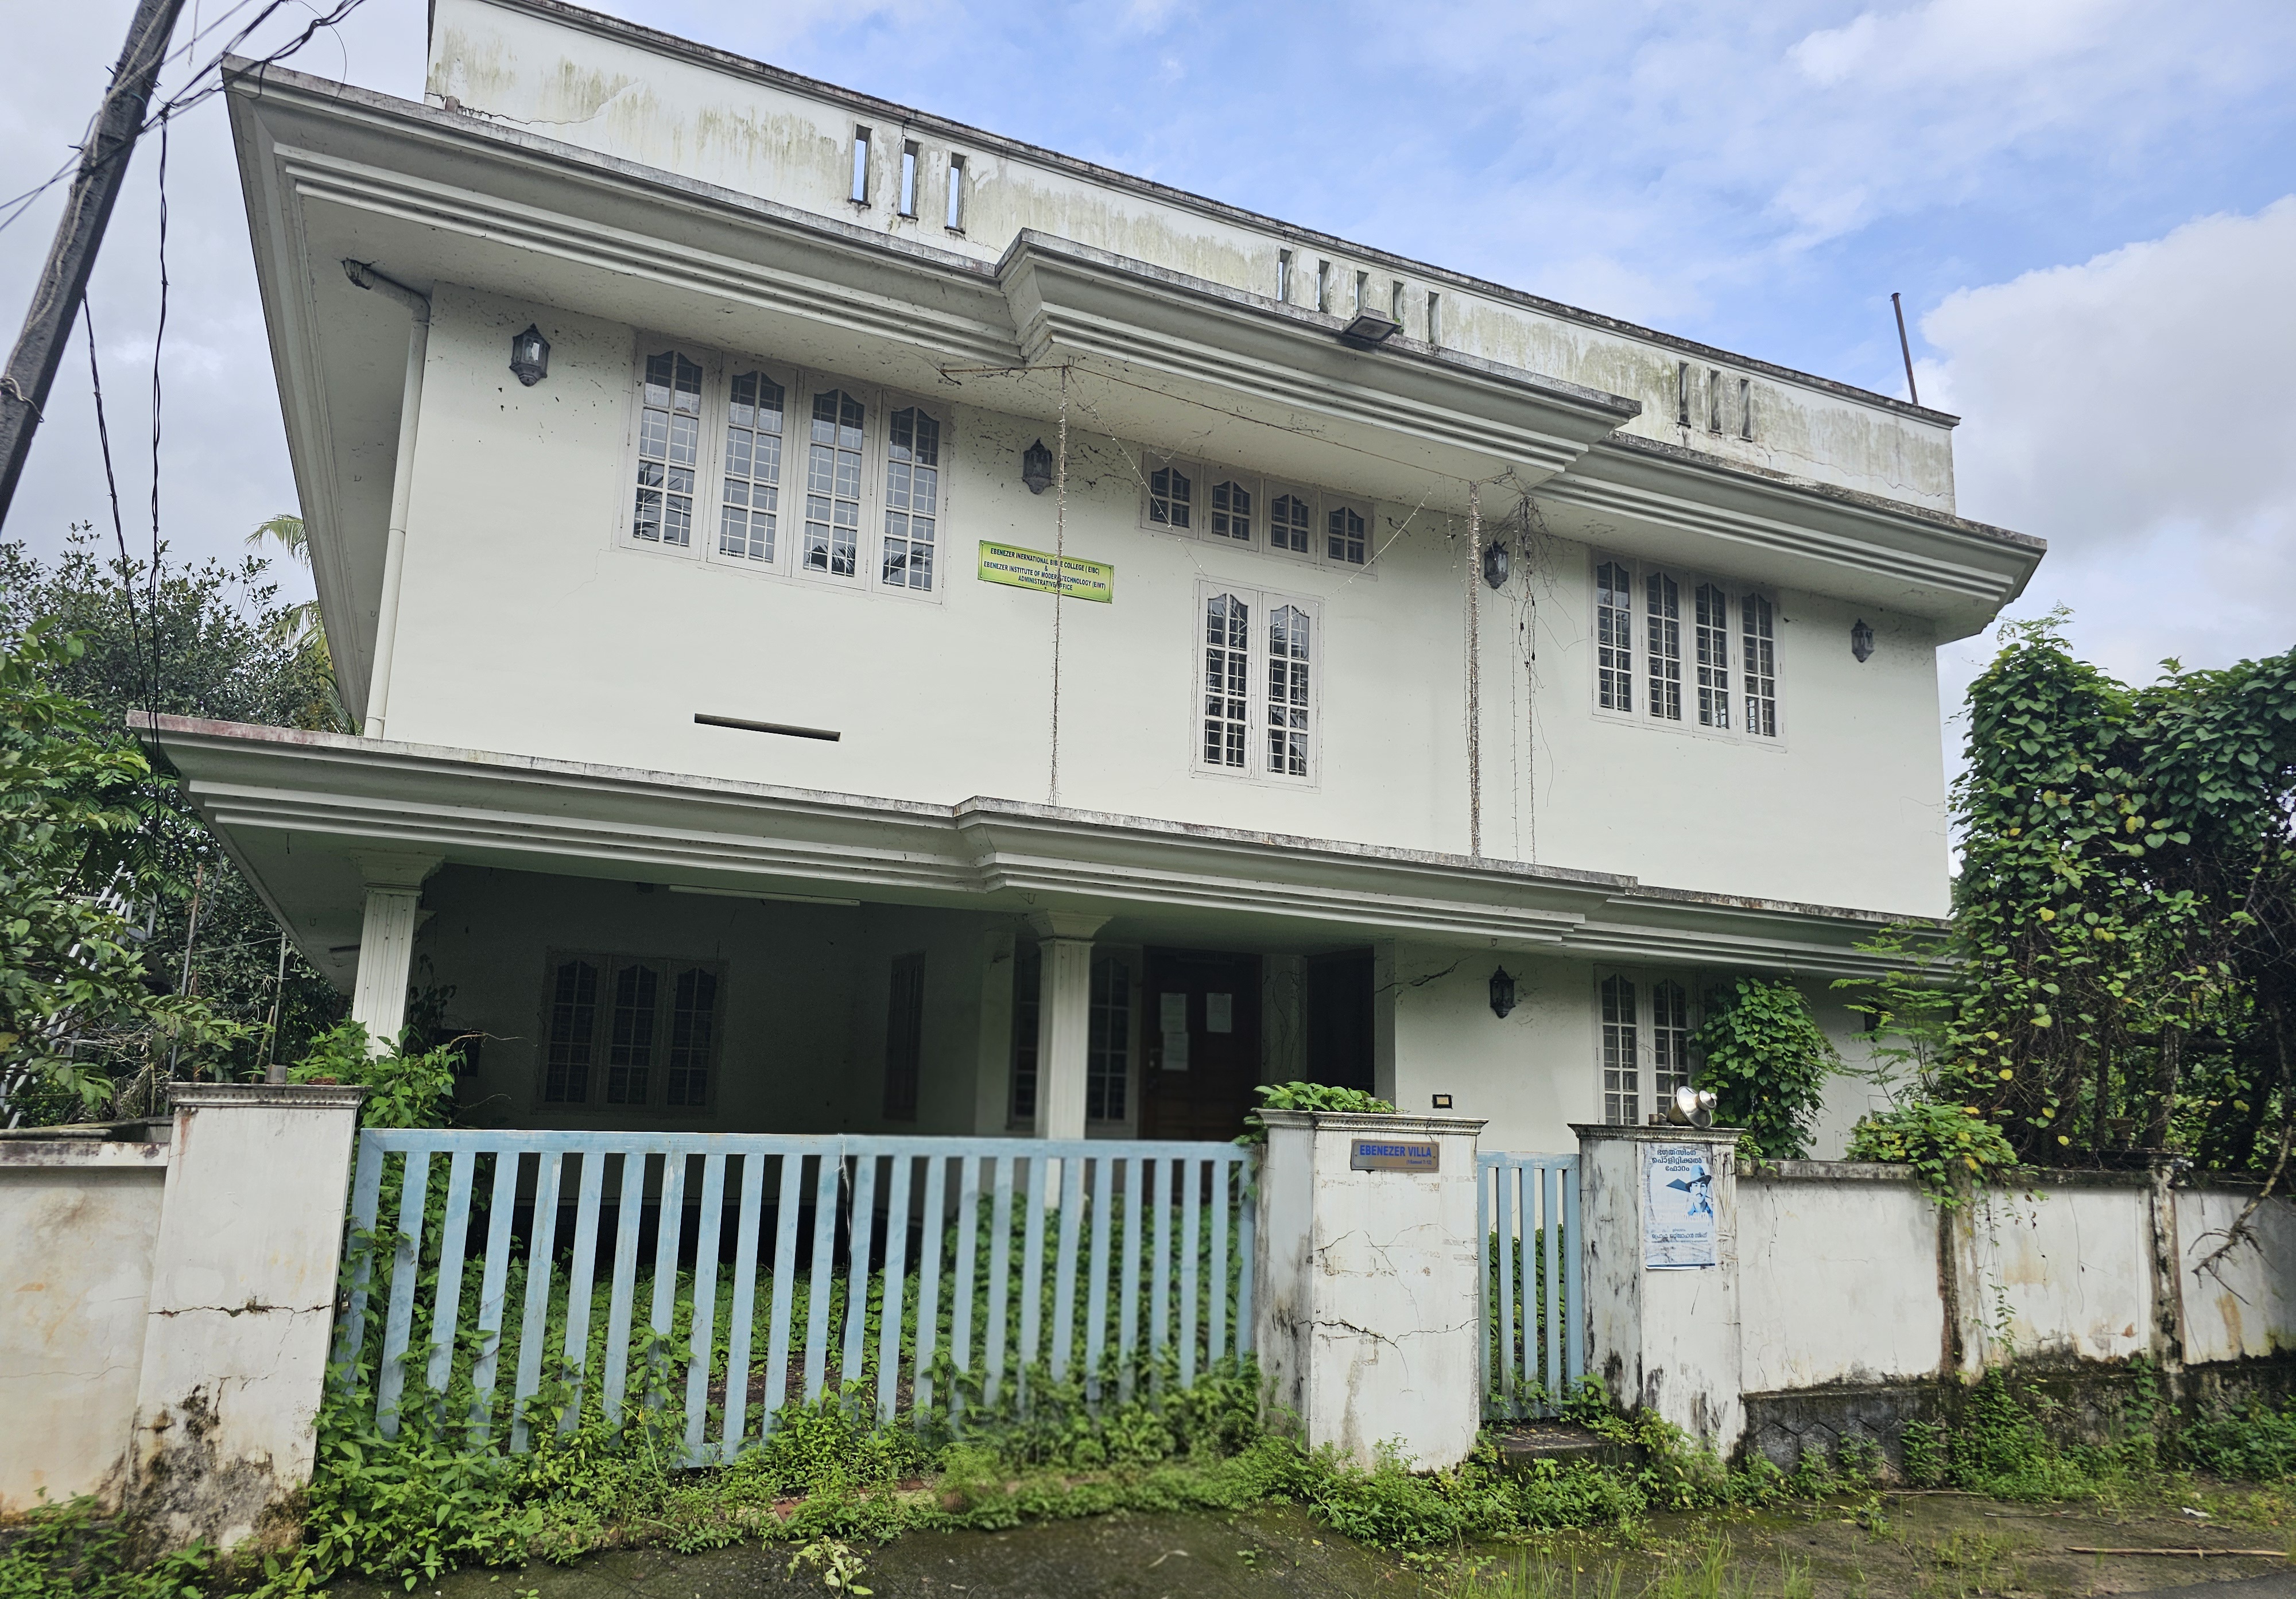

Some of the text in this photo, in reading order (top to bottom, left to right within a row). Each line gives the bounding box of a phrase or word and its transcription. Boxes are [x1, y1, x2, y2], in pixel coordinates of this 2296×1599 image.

[991, 548, 1015, 558] EBENEZER
[1016, 553, 1049, 564] INERNATIONAL
[1064, 562, 1084, 571] COLLEGE
[984, 561, 1008, 570] EBENEZER
[1009, 566, 1033, 575] INSTITUTE
[1041, 572, 1060, 581] MODER
[1092, 581, 1106, 590] (EIMT)
[1018, 576, 1072, 591] ADMINISTRATIVE FFICE
[1360, 1144, 1432, 1157] EBENEZER VILLA
